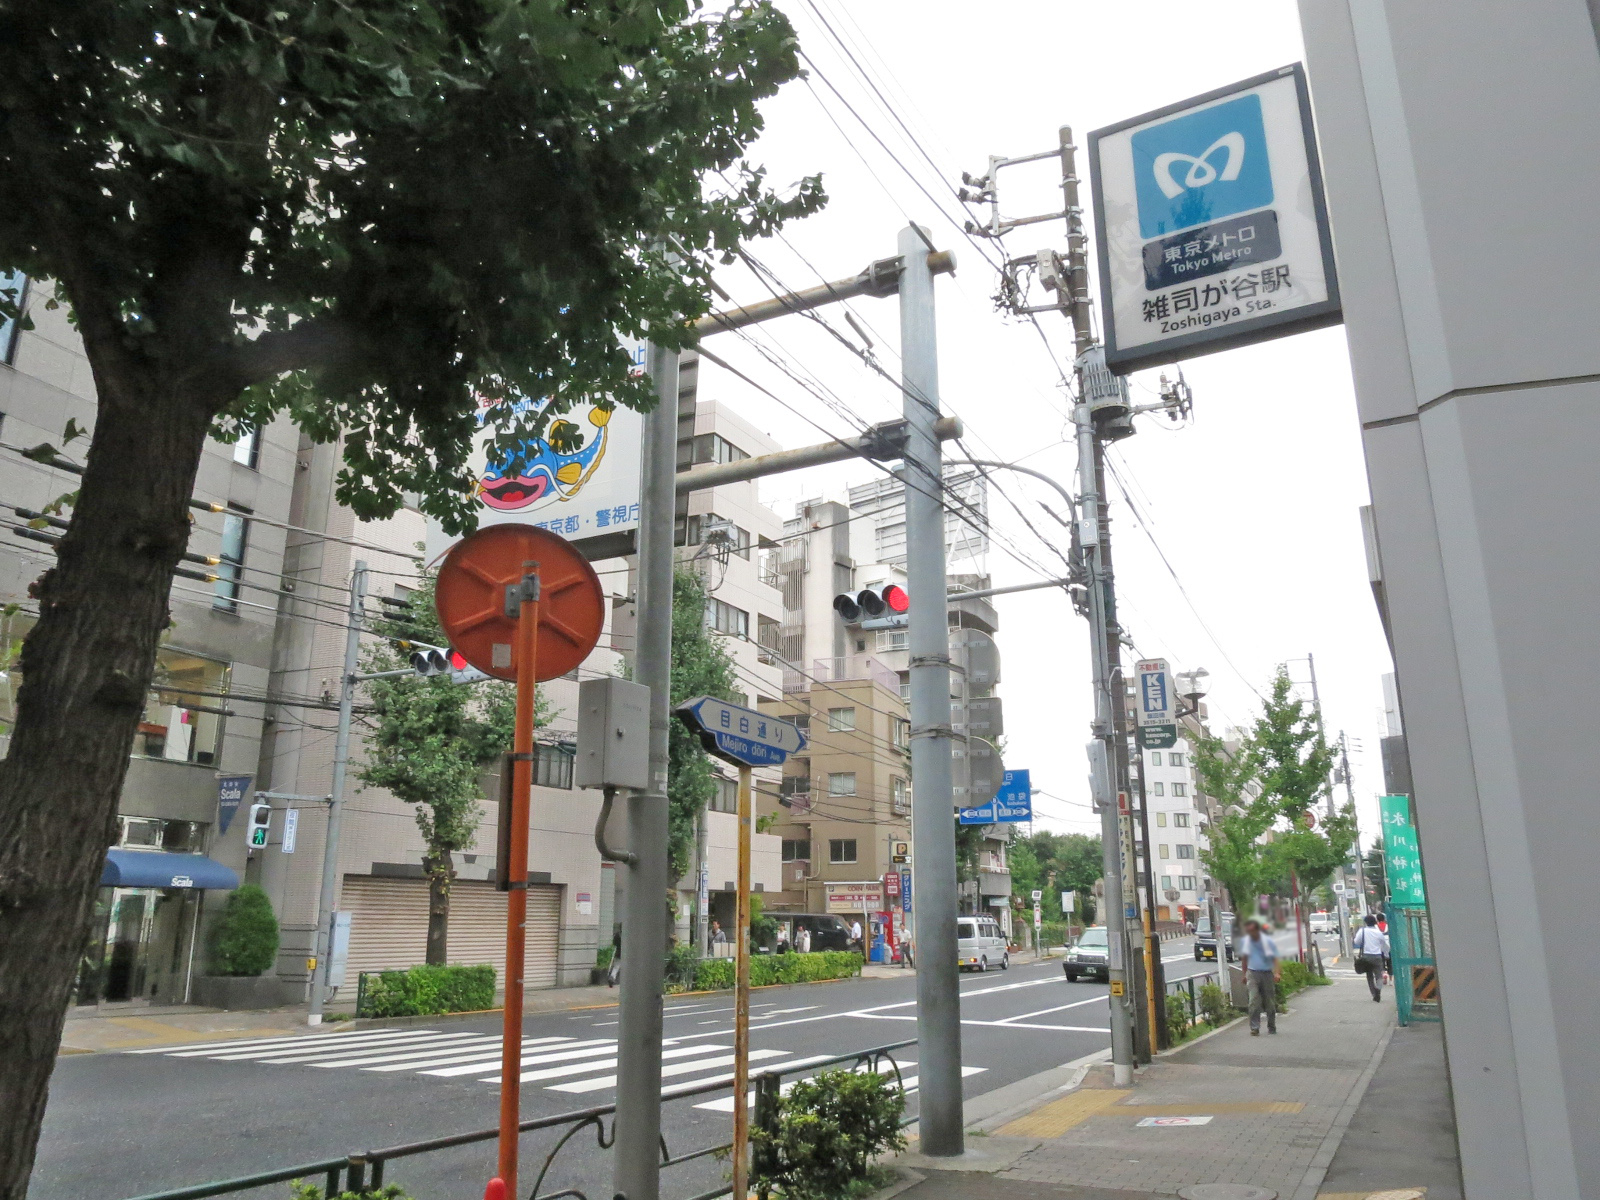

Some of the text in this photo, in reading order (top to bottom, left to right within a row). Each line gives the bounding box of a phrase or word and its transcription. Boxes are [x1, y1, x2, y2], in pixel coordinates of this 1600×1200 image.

[1163, 225, 1256, 263] 東京メトロ
[1171, 244, 1252, 275] Tokyo Metro
[1142, 264, 1293, 323] 雑司が谷駅
[1161, 296, 1277, 334] Zoshigaya Sta.
[1147, 674, 1162, 710] KEN
[721, 709, 783, 743] 目白通り
[722, 734, 748, 754] Mejiro
[220, 788, 241, 799] Scala
[171, 877, 193, 888] Scala
[903, 875, 911, 910] クリーニング
